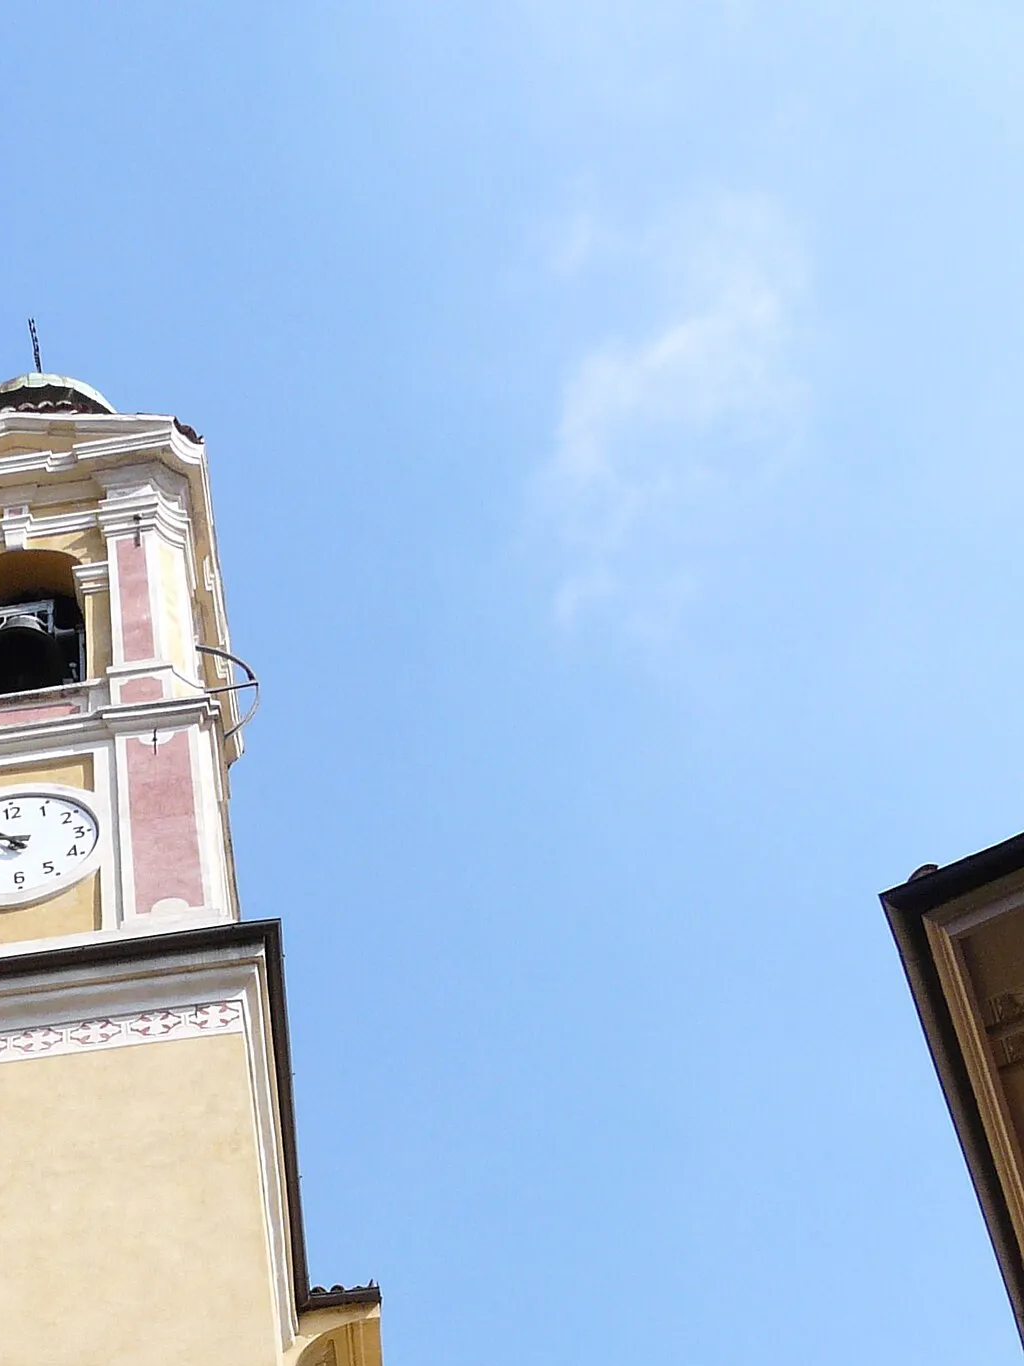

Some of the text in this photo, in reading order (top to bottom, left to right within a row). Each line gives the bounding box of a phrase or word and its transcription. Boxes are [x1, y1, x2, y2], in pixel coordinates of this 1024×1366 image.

[3, 807, 21, 820] 12
[40, 806, 46, 816] 1
[61, 812, 72, 824] 2
[73, 826, 85, 838] 3
[66, 845, 77, 856] 4
[43, 862, 54, 874] 5
[14, 872, 24, 884] 6
